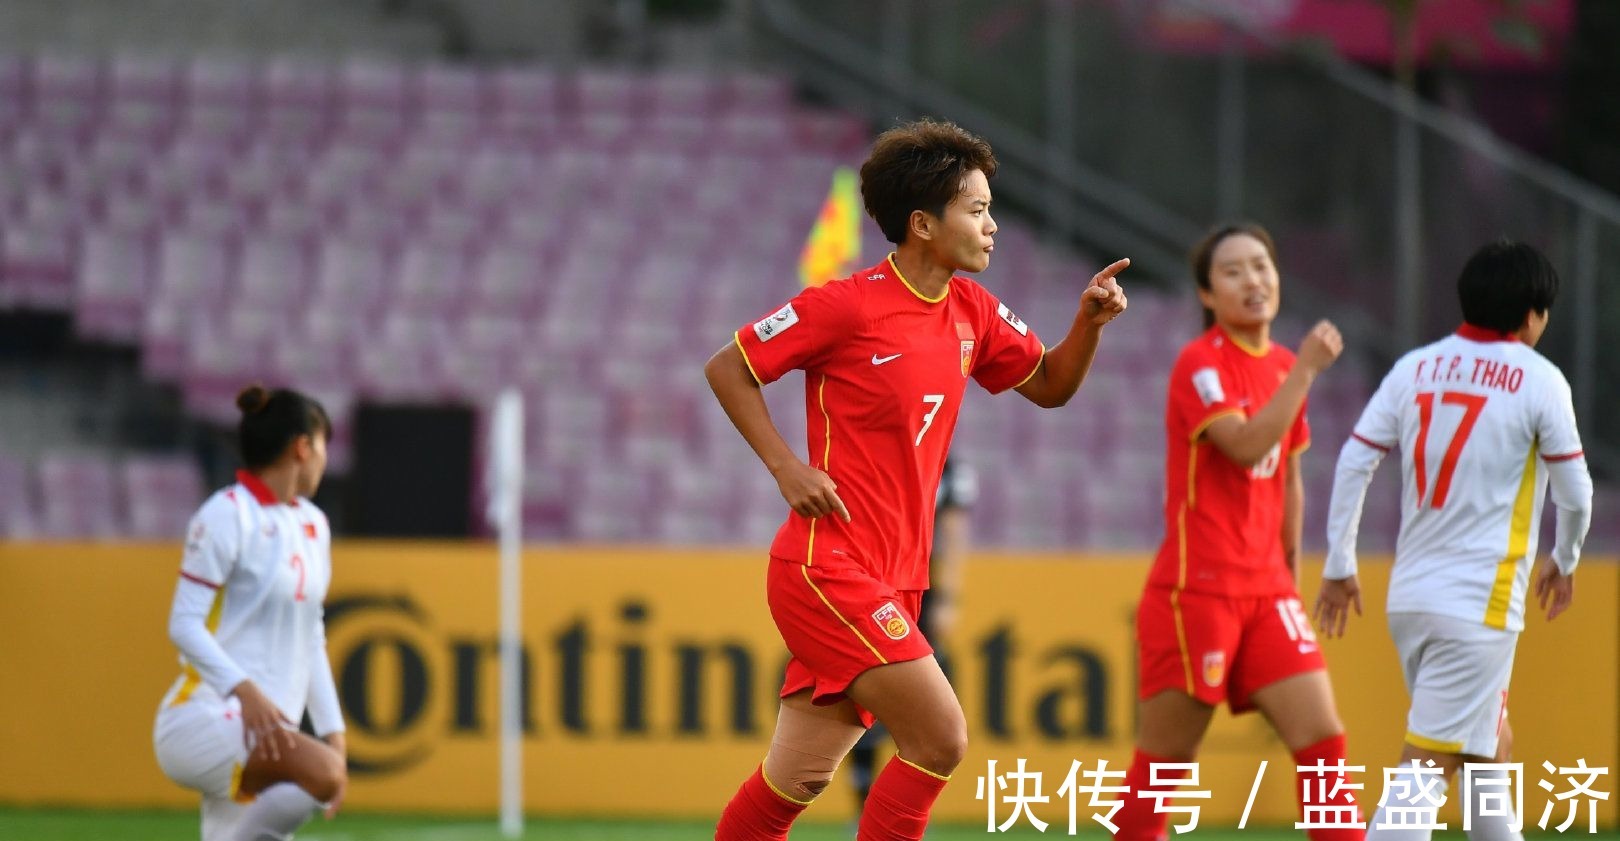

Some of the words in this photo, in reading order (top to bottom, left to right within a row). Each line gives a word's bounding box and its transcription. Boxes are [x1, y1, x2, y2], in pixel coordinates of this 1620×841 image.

[1470, 357, 1524, 395] THAO
[915, 394, 944, 447] 7
[1413, 390, 1489, 511] 17
